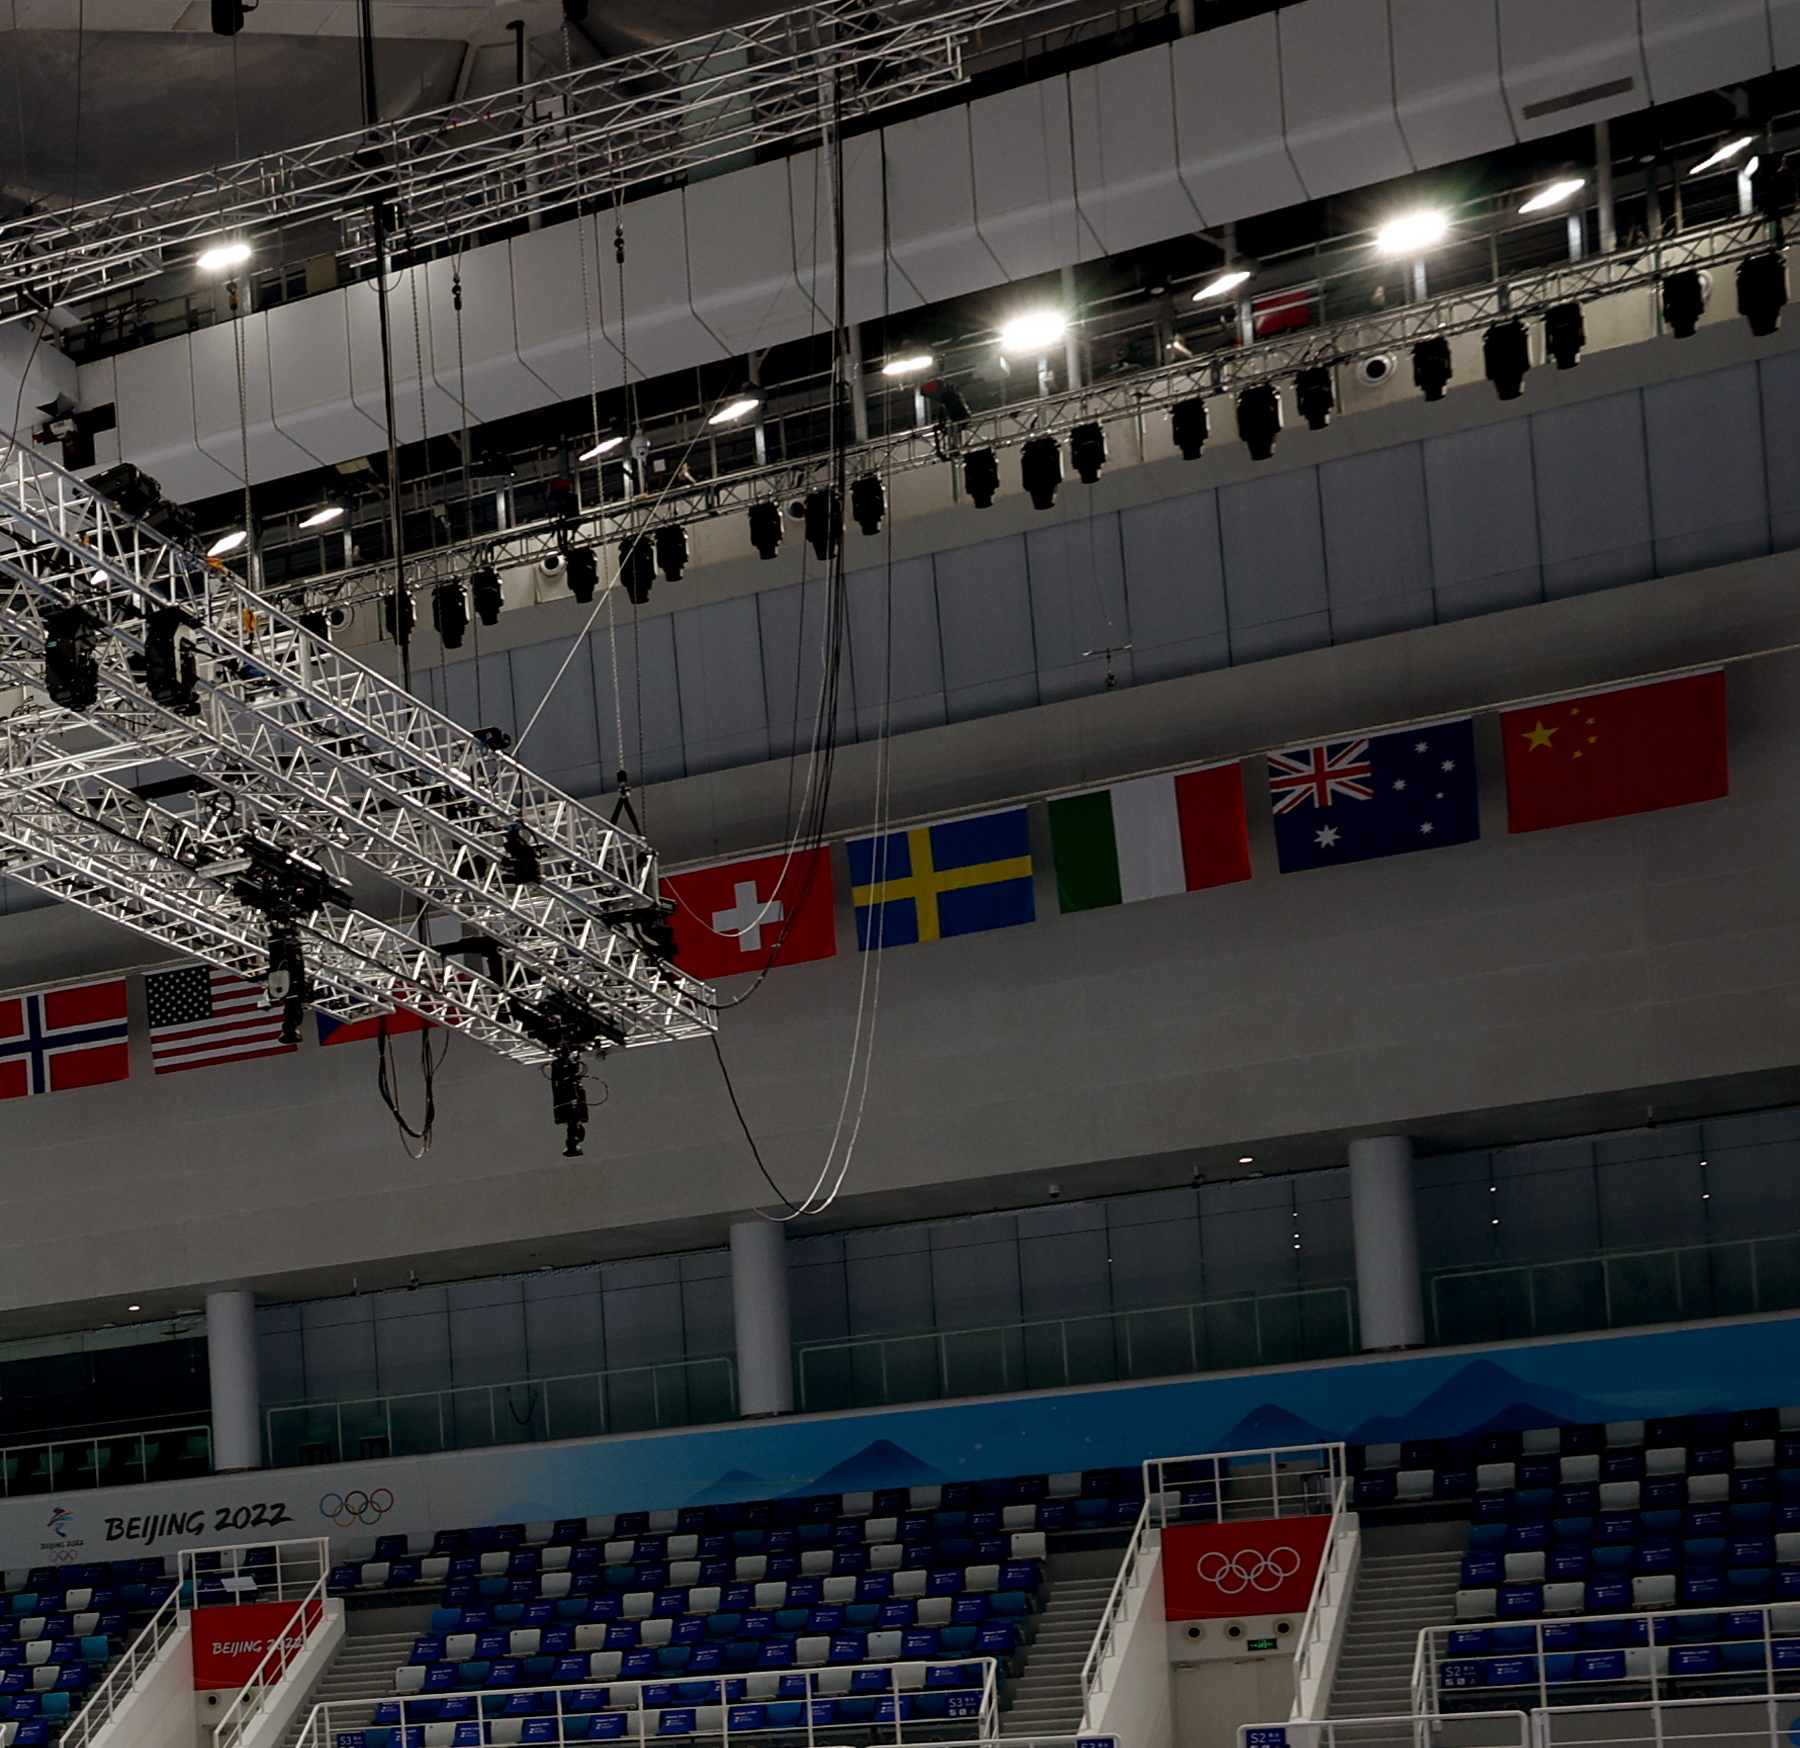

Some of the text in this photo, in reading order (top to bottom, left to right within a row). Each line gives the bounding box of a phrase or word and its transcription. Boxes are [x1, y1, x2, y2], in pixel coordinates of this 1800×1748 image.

[105, 1503, 295, 1546] BEIJING 2022
[212, 1640, 262, 1656] BEIJING
[1446, 1667, 1461, 1677] S2
[949, 1698, 963, 1707] S3
[340, 1736, 352, 1745] S3
[1250, 1733, 1266, 1743] S2
